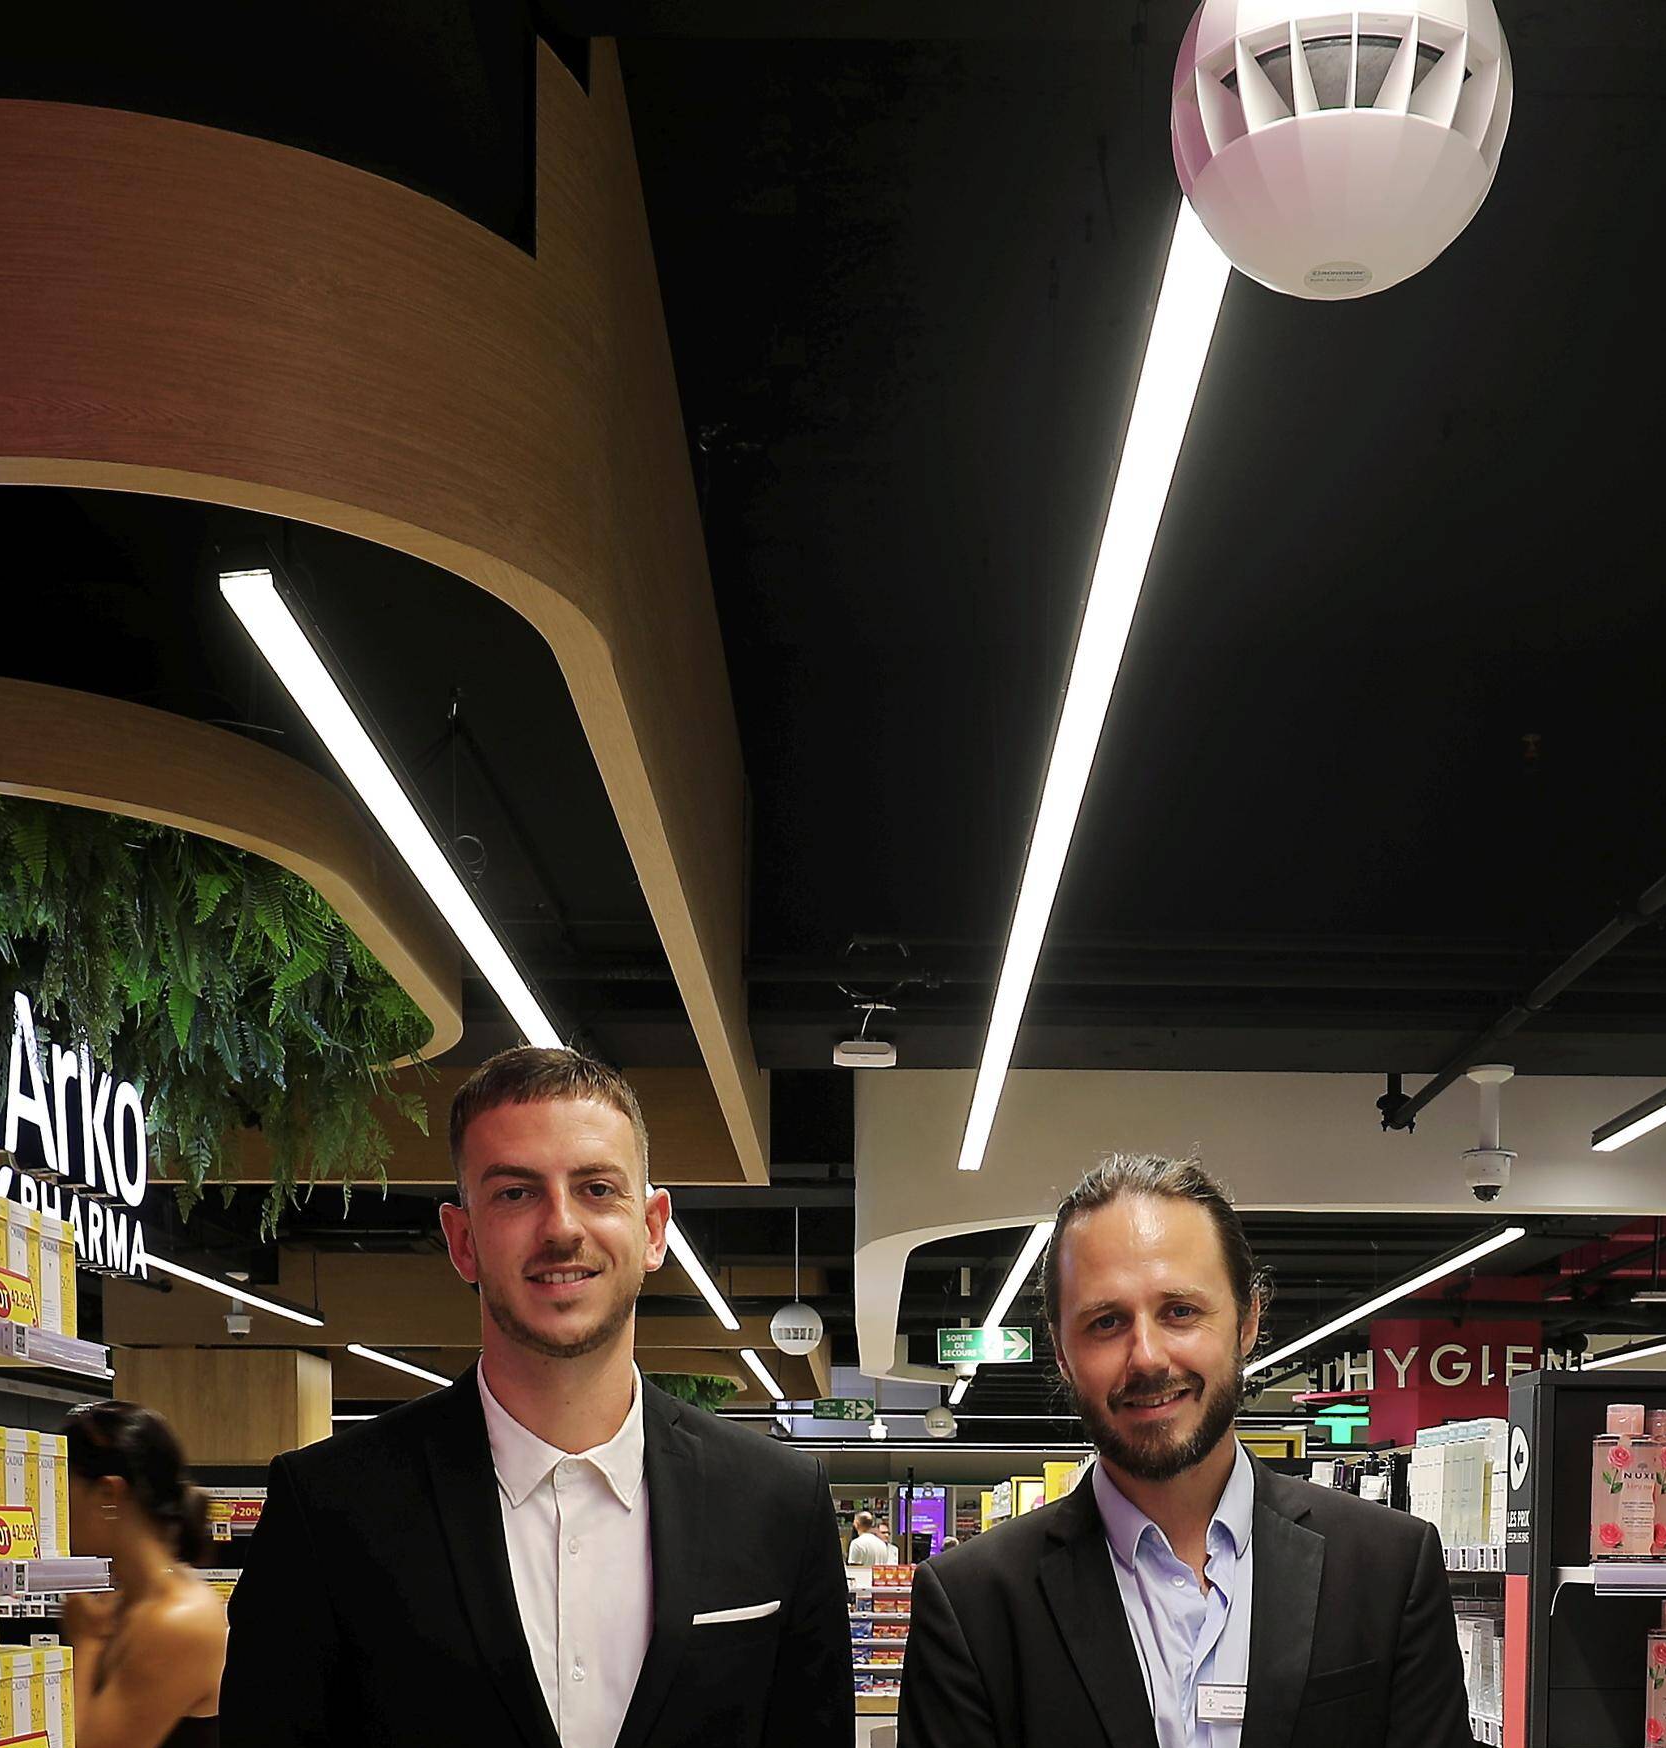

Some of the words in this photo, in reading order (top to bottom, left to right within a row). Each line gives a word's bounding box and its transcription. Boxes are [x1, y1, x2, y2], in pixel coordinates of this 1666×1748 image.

[5, 990, 147, 1207] Arko
[20, 1174, 148, 1280] PHARMA
[10, 1289, 34, 1312] 42.99€
[946, 1334, 973, 1342] SORTIE
[941, 1349, 977, 1357] SECOURS
[12, 1524, 36, 1541] 42.99€
